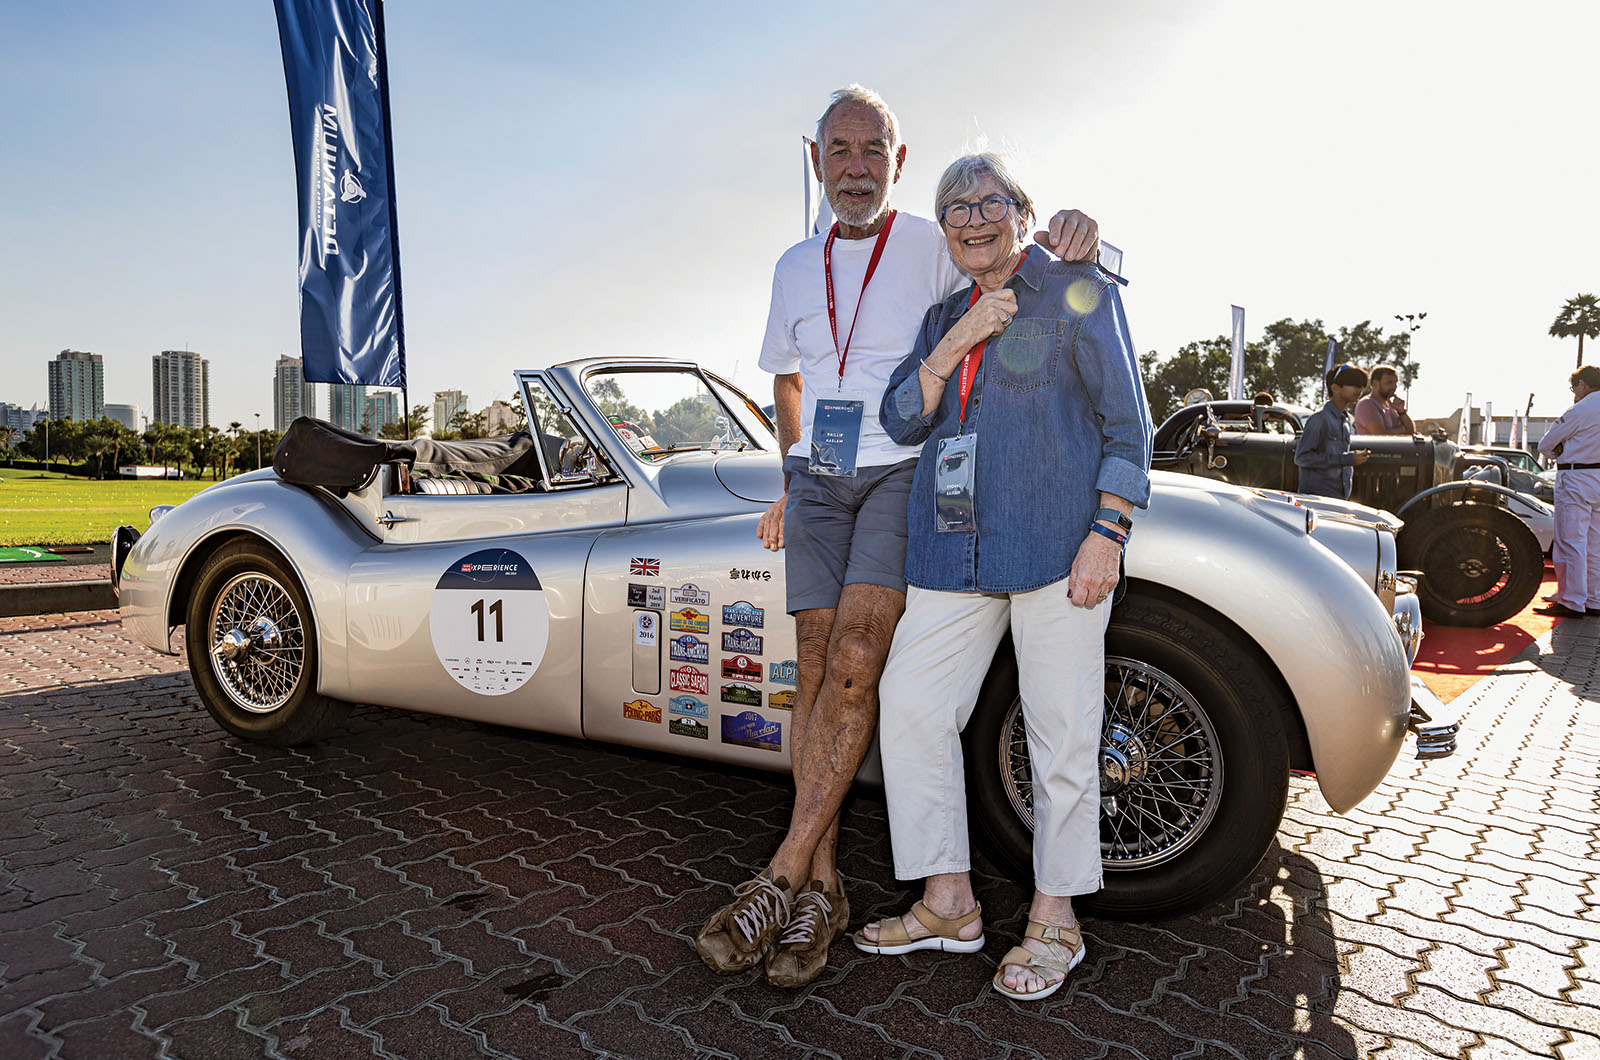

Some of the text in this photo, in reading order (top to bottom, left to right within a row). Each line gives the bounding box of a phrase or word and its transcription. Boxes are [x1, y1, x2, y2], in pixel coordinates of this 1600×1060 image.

[674, 596, 706, 604] VERIFICATO
[471, 599, 503, 642] 11
[729, 613, 762, 623] ADVENTURE
[639, 631, 655, 639] 2016
[671, 671, 690, 688] CLASSIC
[690, 674, 708, 694] SAFARI
[744, 712, 757, 721] 2017
